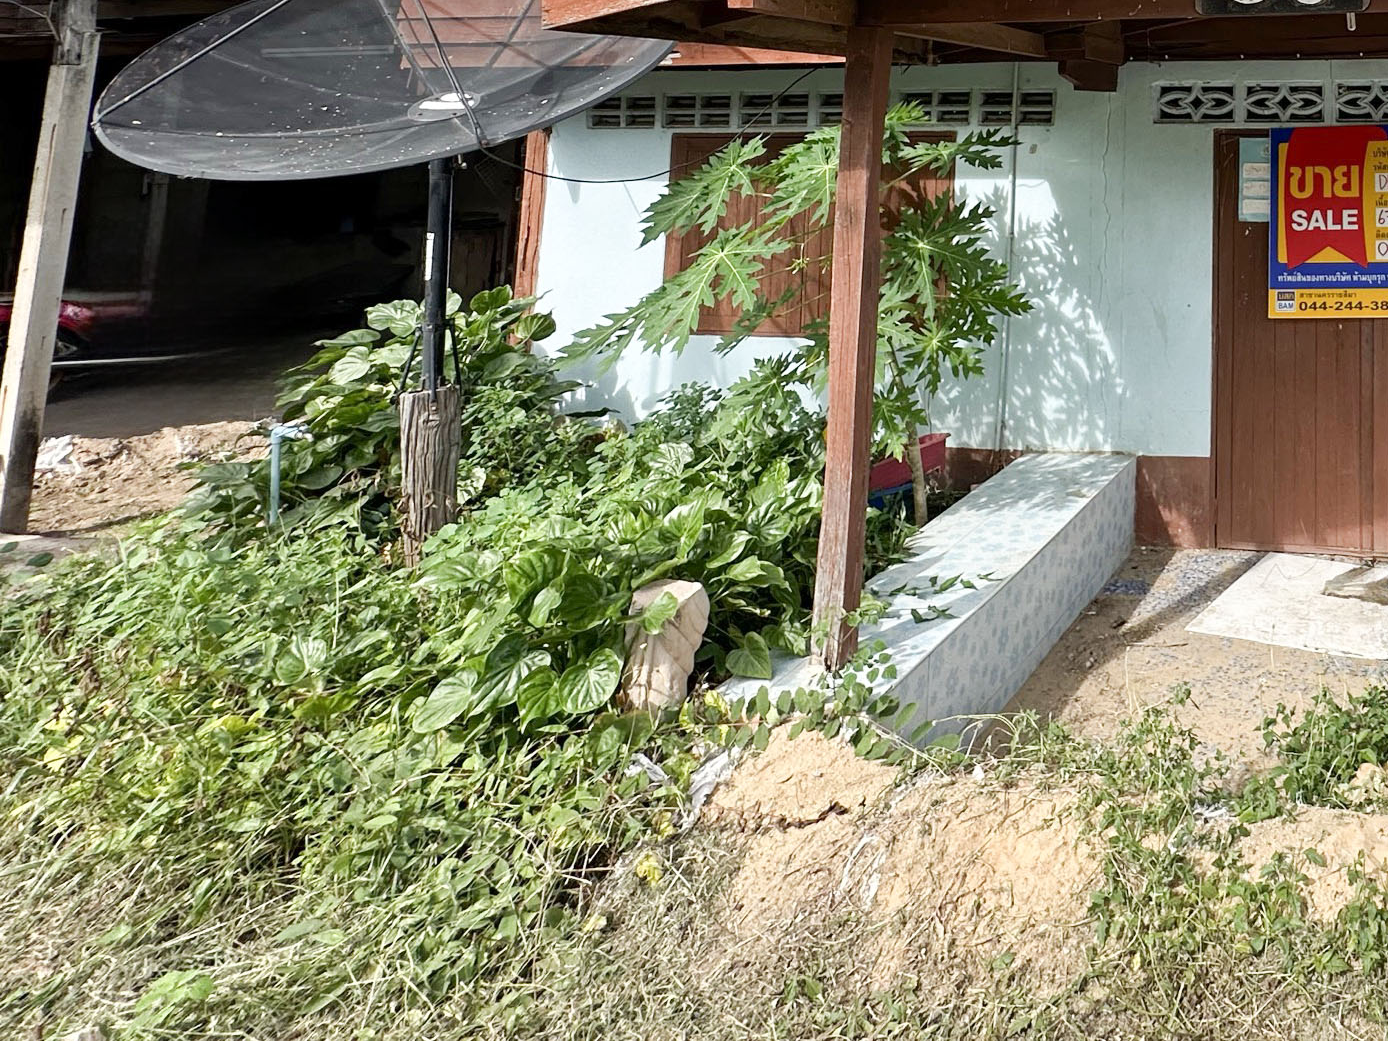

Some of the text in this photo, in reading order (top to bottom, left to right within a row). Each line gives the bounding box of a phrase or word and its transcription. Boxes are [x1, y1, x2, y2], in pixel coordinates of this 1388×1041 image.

[1289, 164, 1360, 199] ขาย
[1291, 209, 1359, 231] SALE
[1352, 271, 1385, 284] ห้ามบุกรุก
[1278, 302, 1294, 310] BAM
